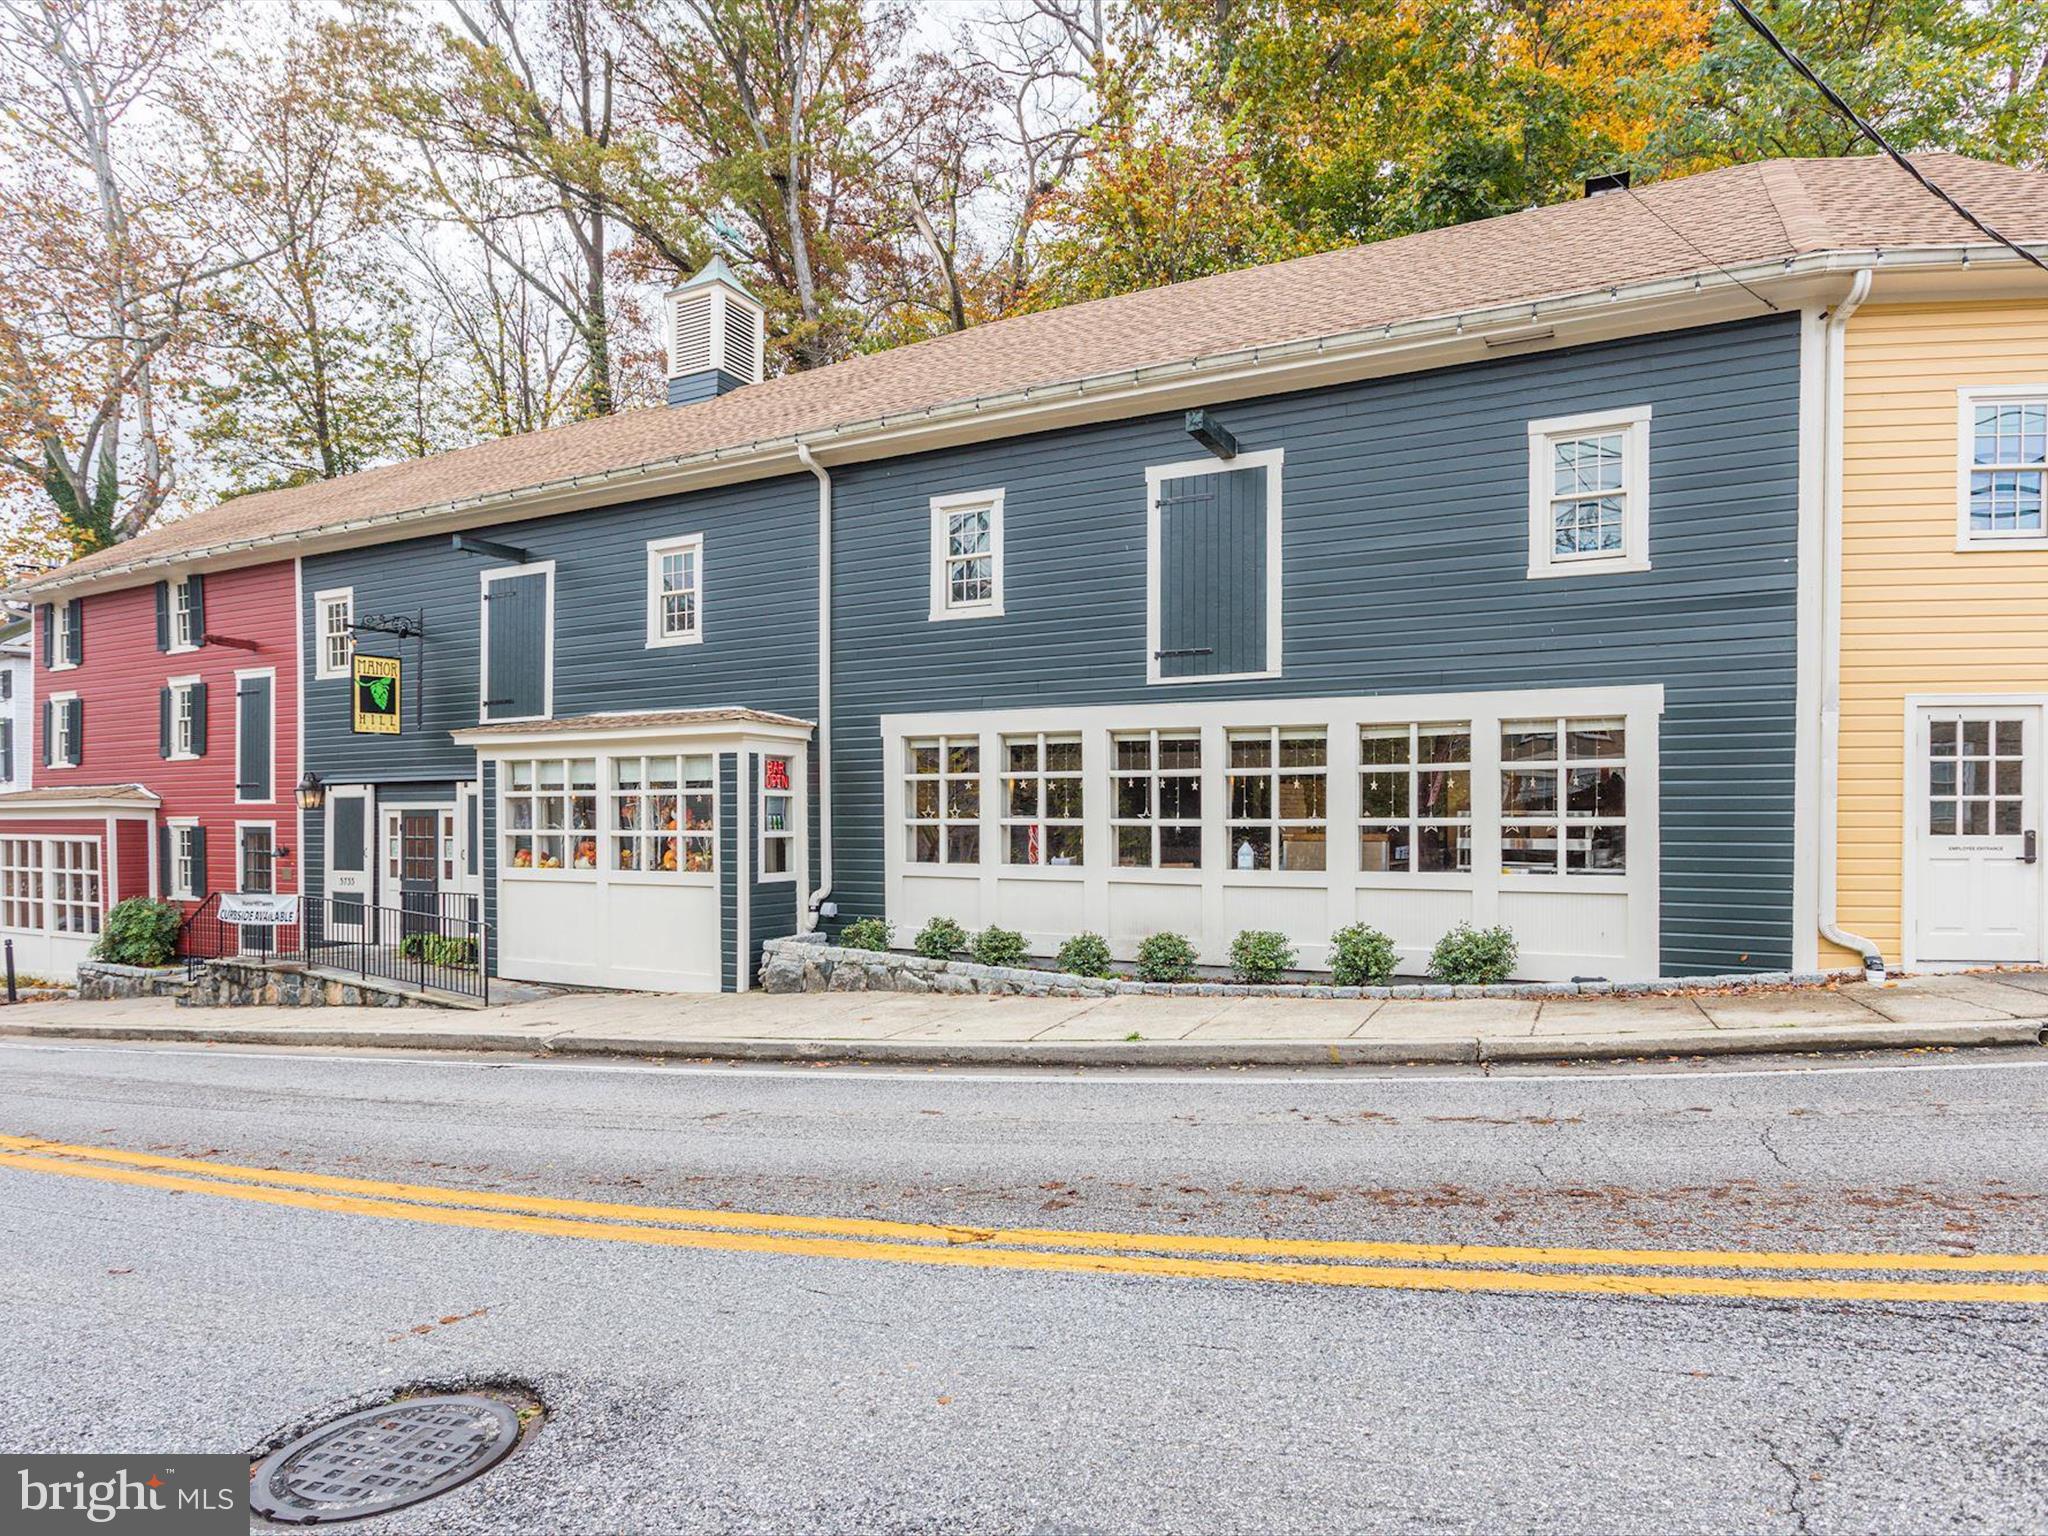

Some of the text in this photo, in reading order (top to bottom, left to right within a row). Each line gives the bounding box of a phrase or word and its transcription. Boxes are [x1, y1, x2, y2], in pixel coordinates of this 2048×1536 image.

[357, 659, 398, 677] MANOR
[359, 714, 396, 726] HILL
[220, 909, 294, 922] CURBSIDE AVAILABLE
